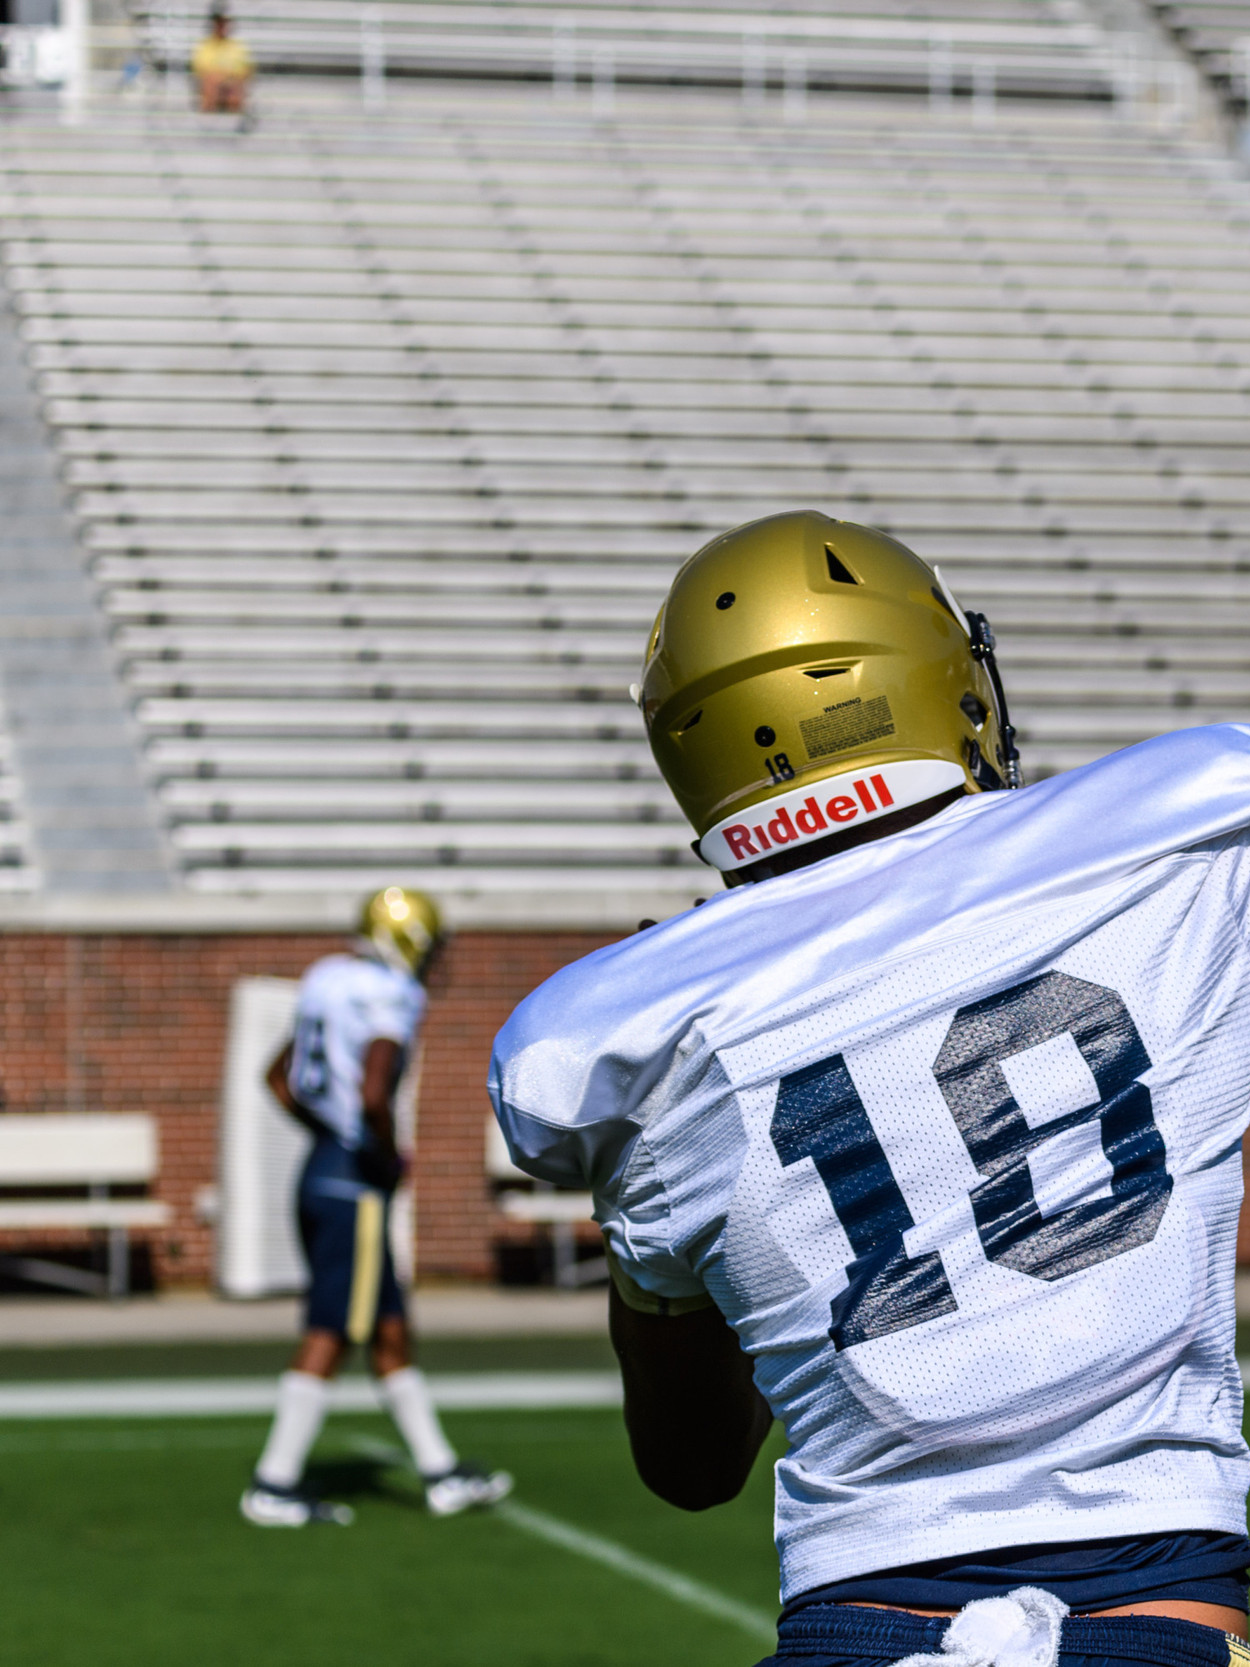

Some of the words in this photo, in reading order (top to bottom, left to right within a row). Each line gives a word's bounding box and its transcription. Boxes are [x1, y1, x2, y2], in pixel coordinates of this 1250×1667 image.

[823, 697, 861, 713] WARNING
[765, 752, 795, 784] 18
[721, 774, 894, 861] Riddell
[769, 969, 1173, 1352] 18
